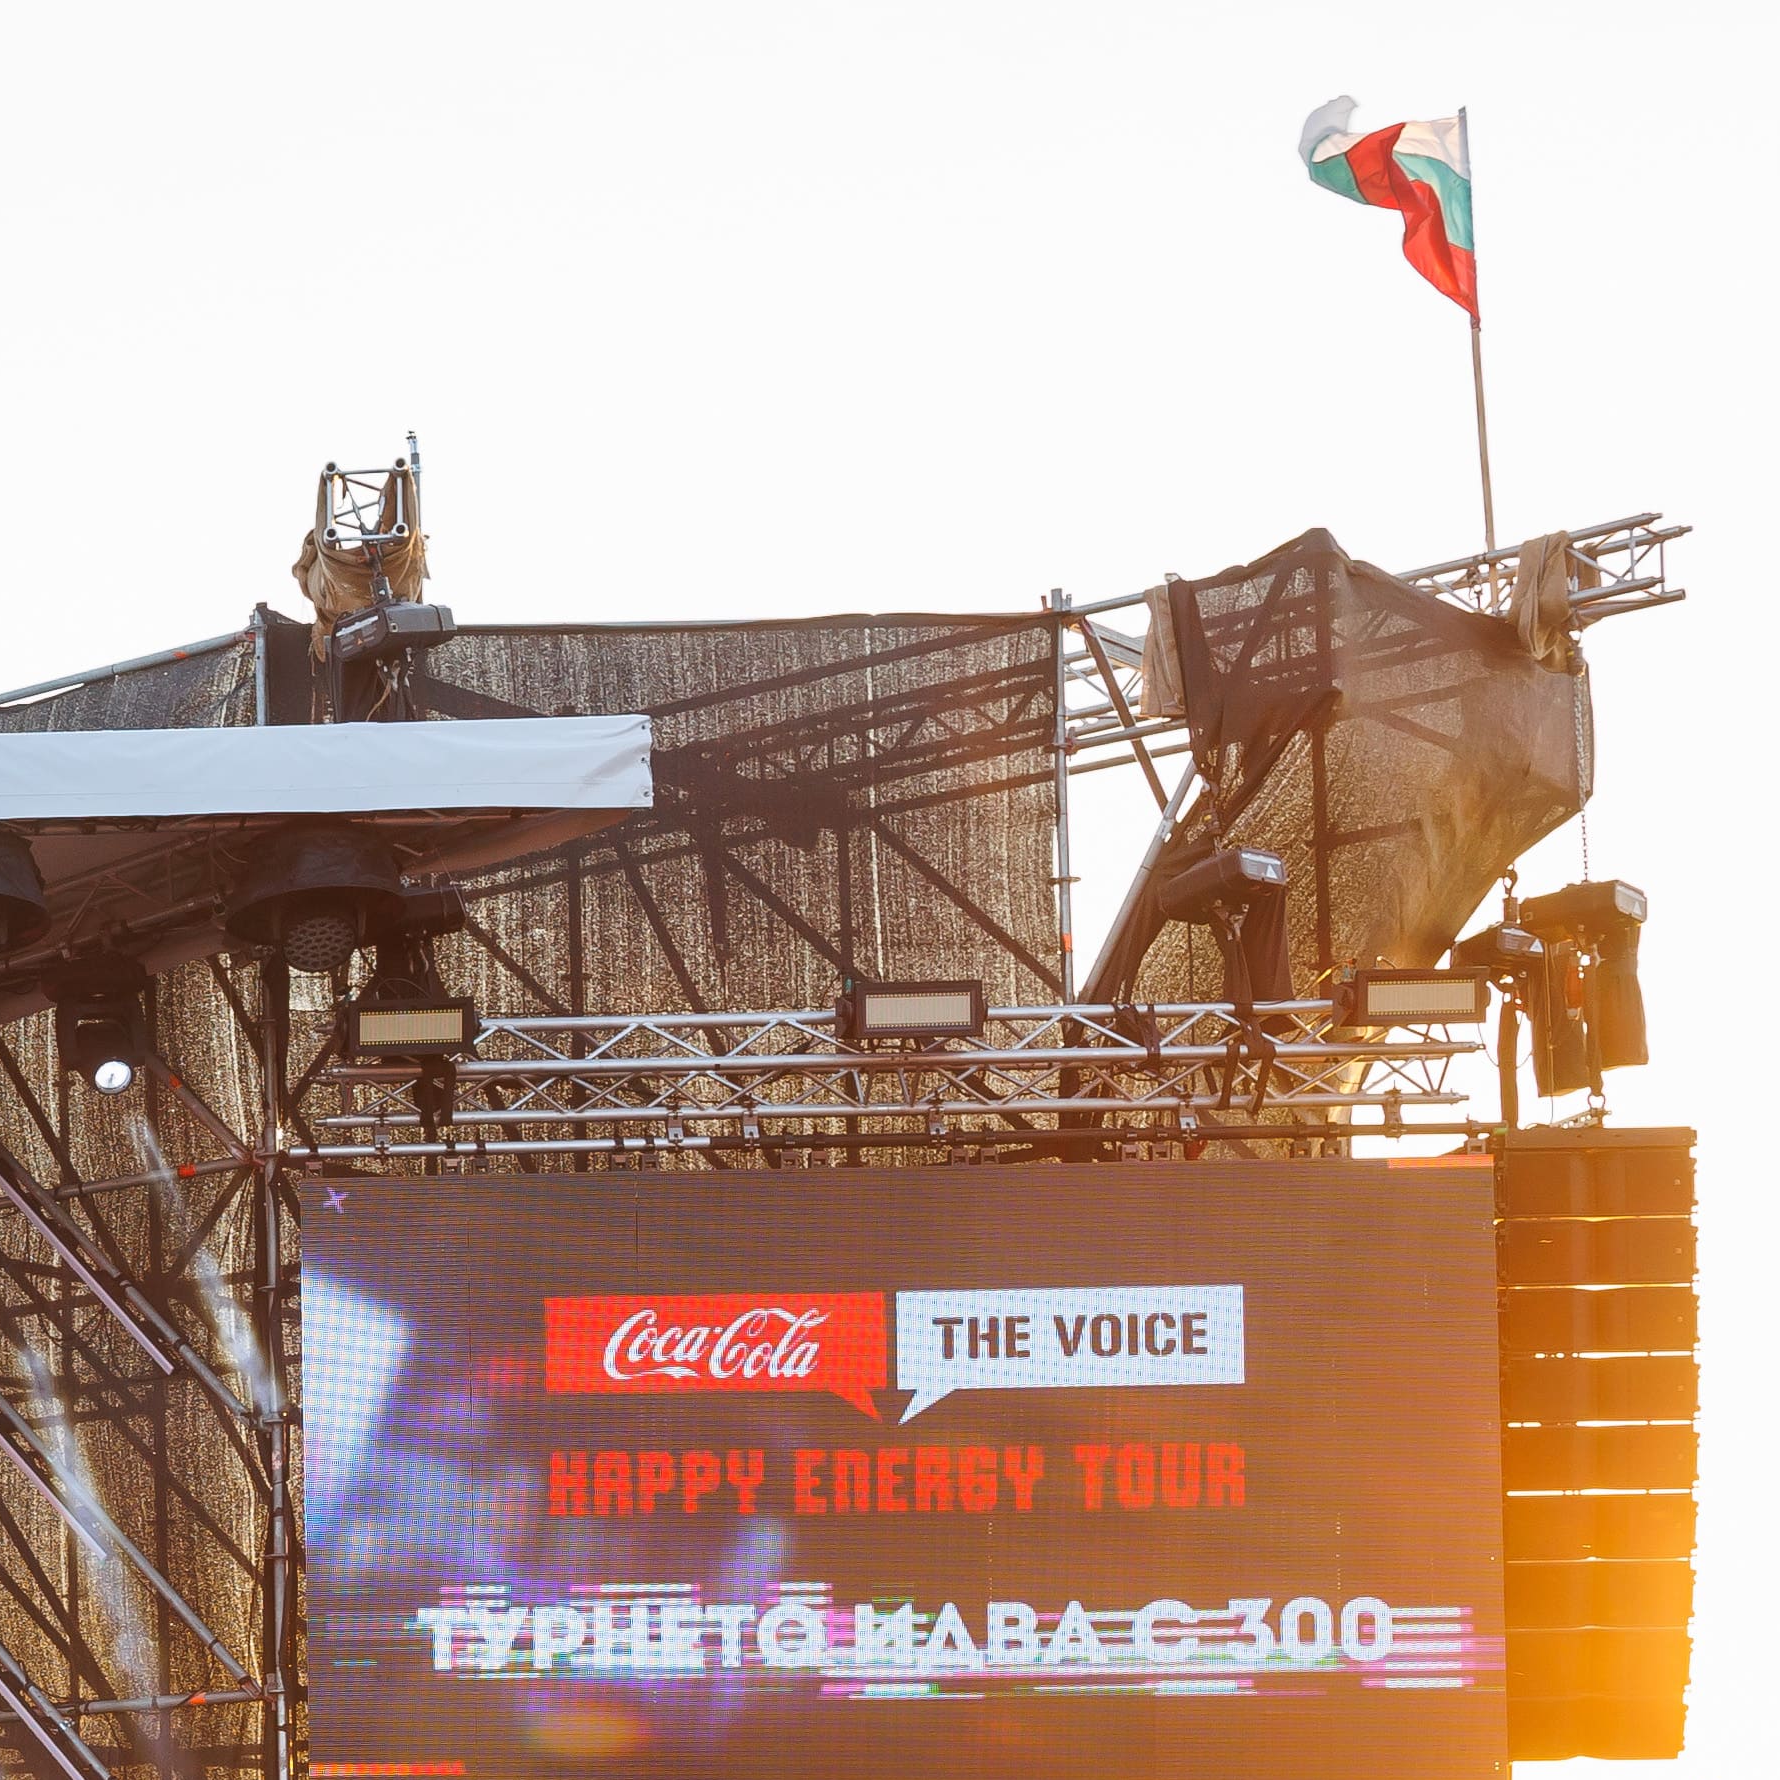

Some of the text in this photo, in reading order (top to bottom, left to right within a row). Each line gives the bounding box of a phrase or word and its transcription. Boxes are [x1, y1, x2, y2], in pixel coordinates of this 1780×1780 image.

[602, 1307, 830, 1380] Coca-Cola
[931, 1312, 1208, 1360] THE VOICE
[548, 1441, 1246, 1518] HAPPY ENERGY TOUR
[1228, 1597, 1394, 1663] 300
